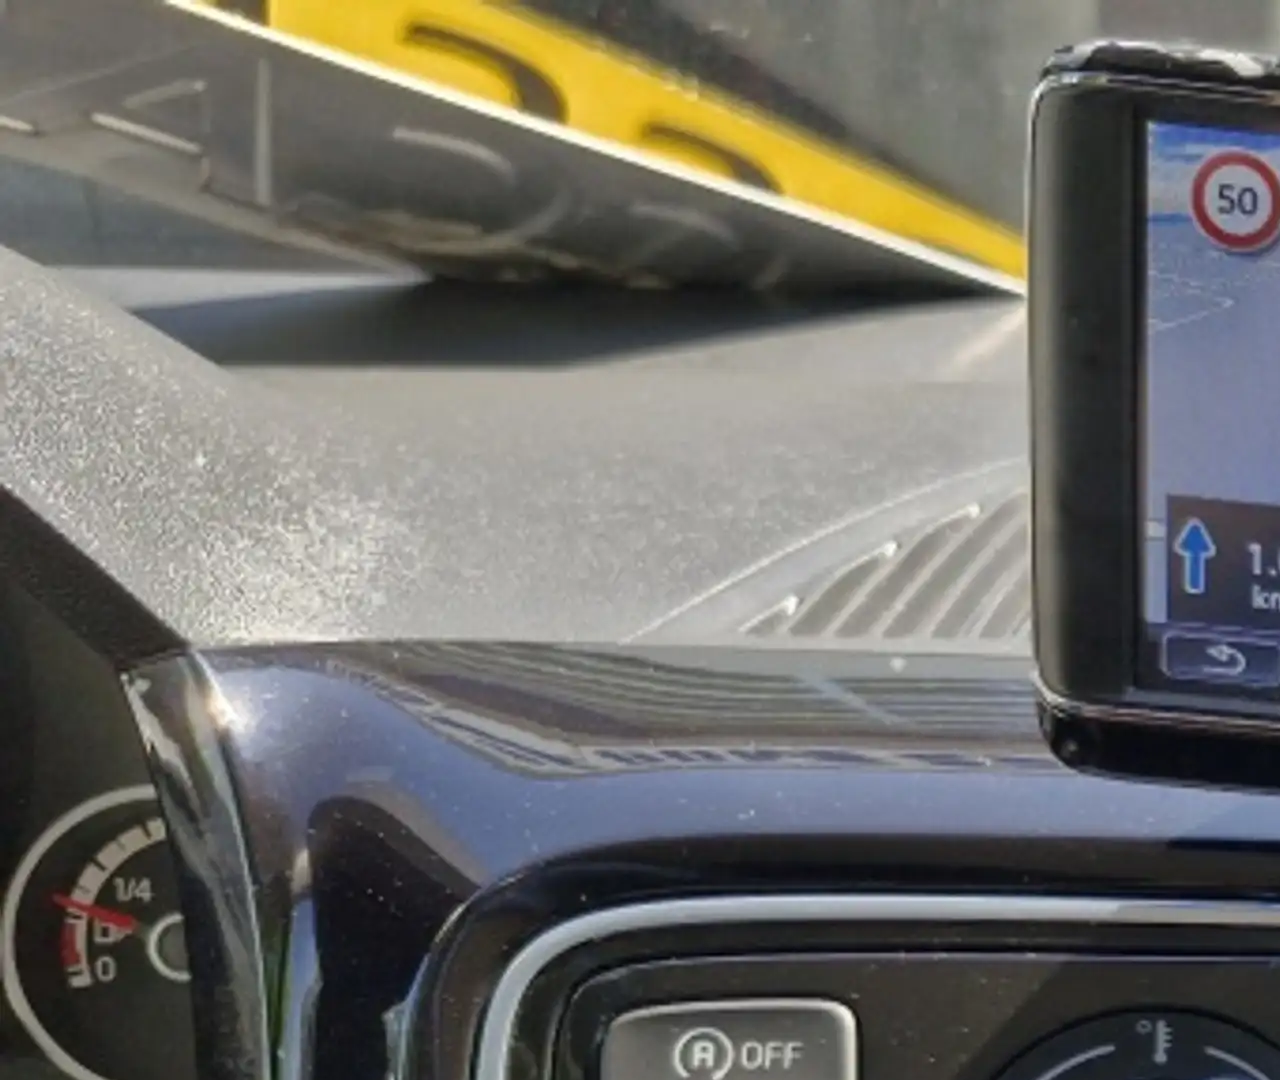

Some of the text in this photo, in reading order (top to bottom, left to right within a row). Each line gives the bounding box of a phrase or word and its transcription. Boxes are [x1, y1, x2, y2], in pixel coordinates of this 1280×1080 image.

[1217, 183, 1258, 215] 50
[114, 877, 154, 902] 1/4
[740, 1042, 802, 1070] OFF
